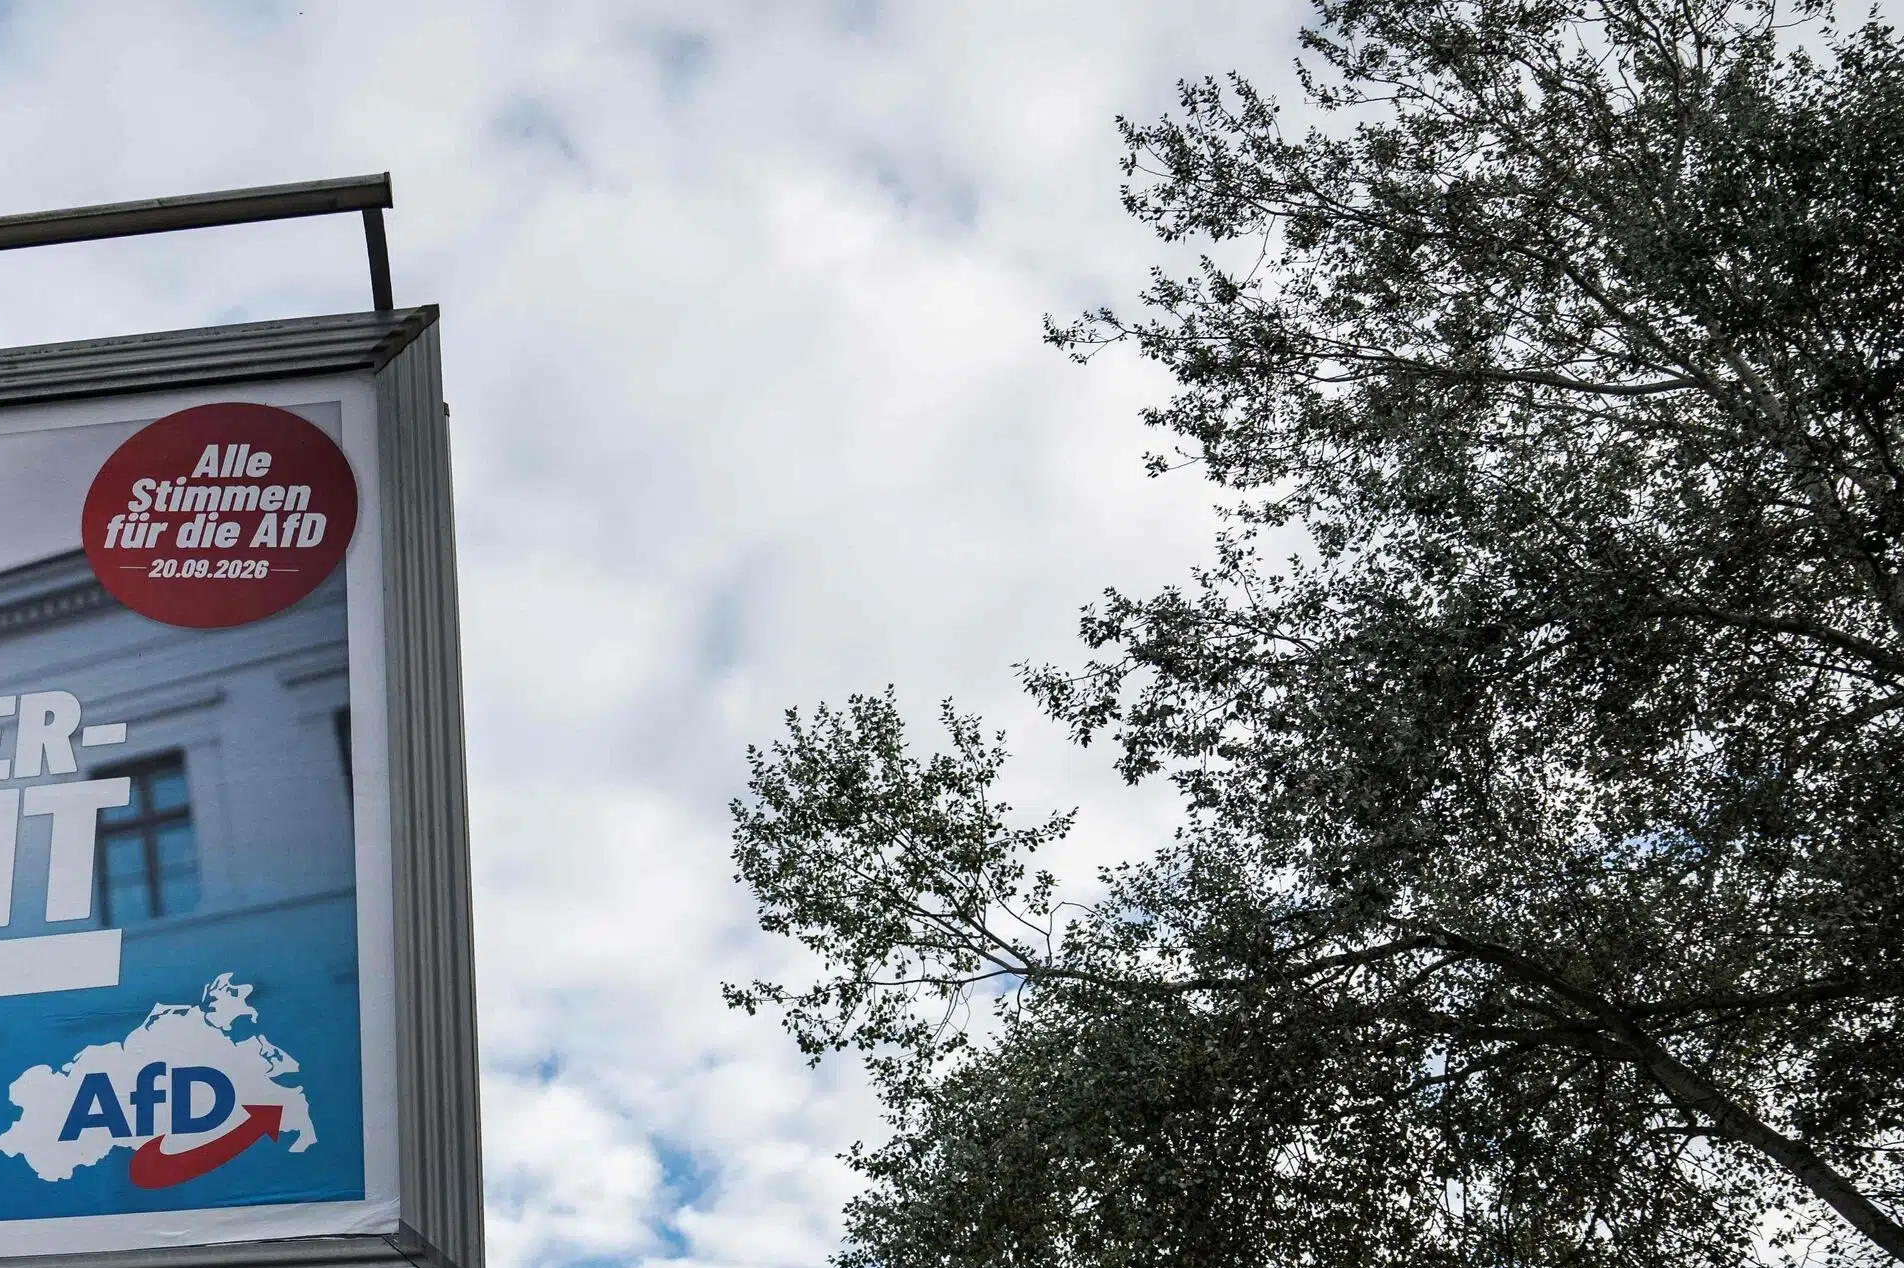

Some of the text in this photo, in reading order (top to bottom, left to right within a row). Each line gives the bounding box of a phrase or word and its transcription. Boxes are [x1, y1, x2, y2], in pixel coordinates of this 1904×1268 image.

[191, 443, 273, 478] Alle
[127, 476, 312, 512] Stimmen
[103, 512, 328, 549] für die AfD
[148, 558, 270, 579] 20.09.2026
[58, 1065, 236, 1142] AfD
